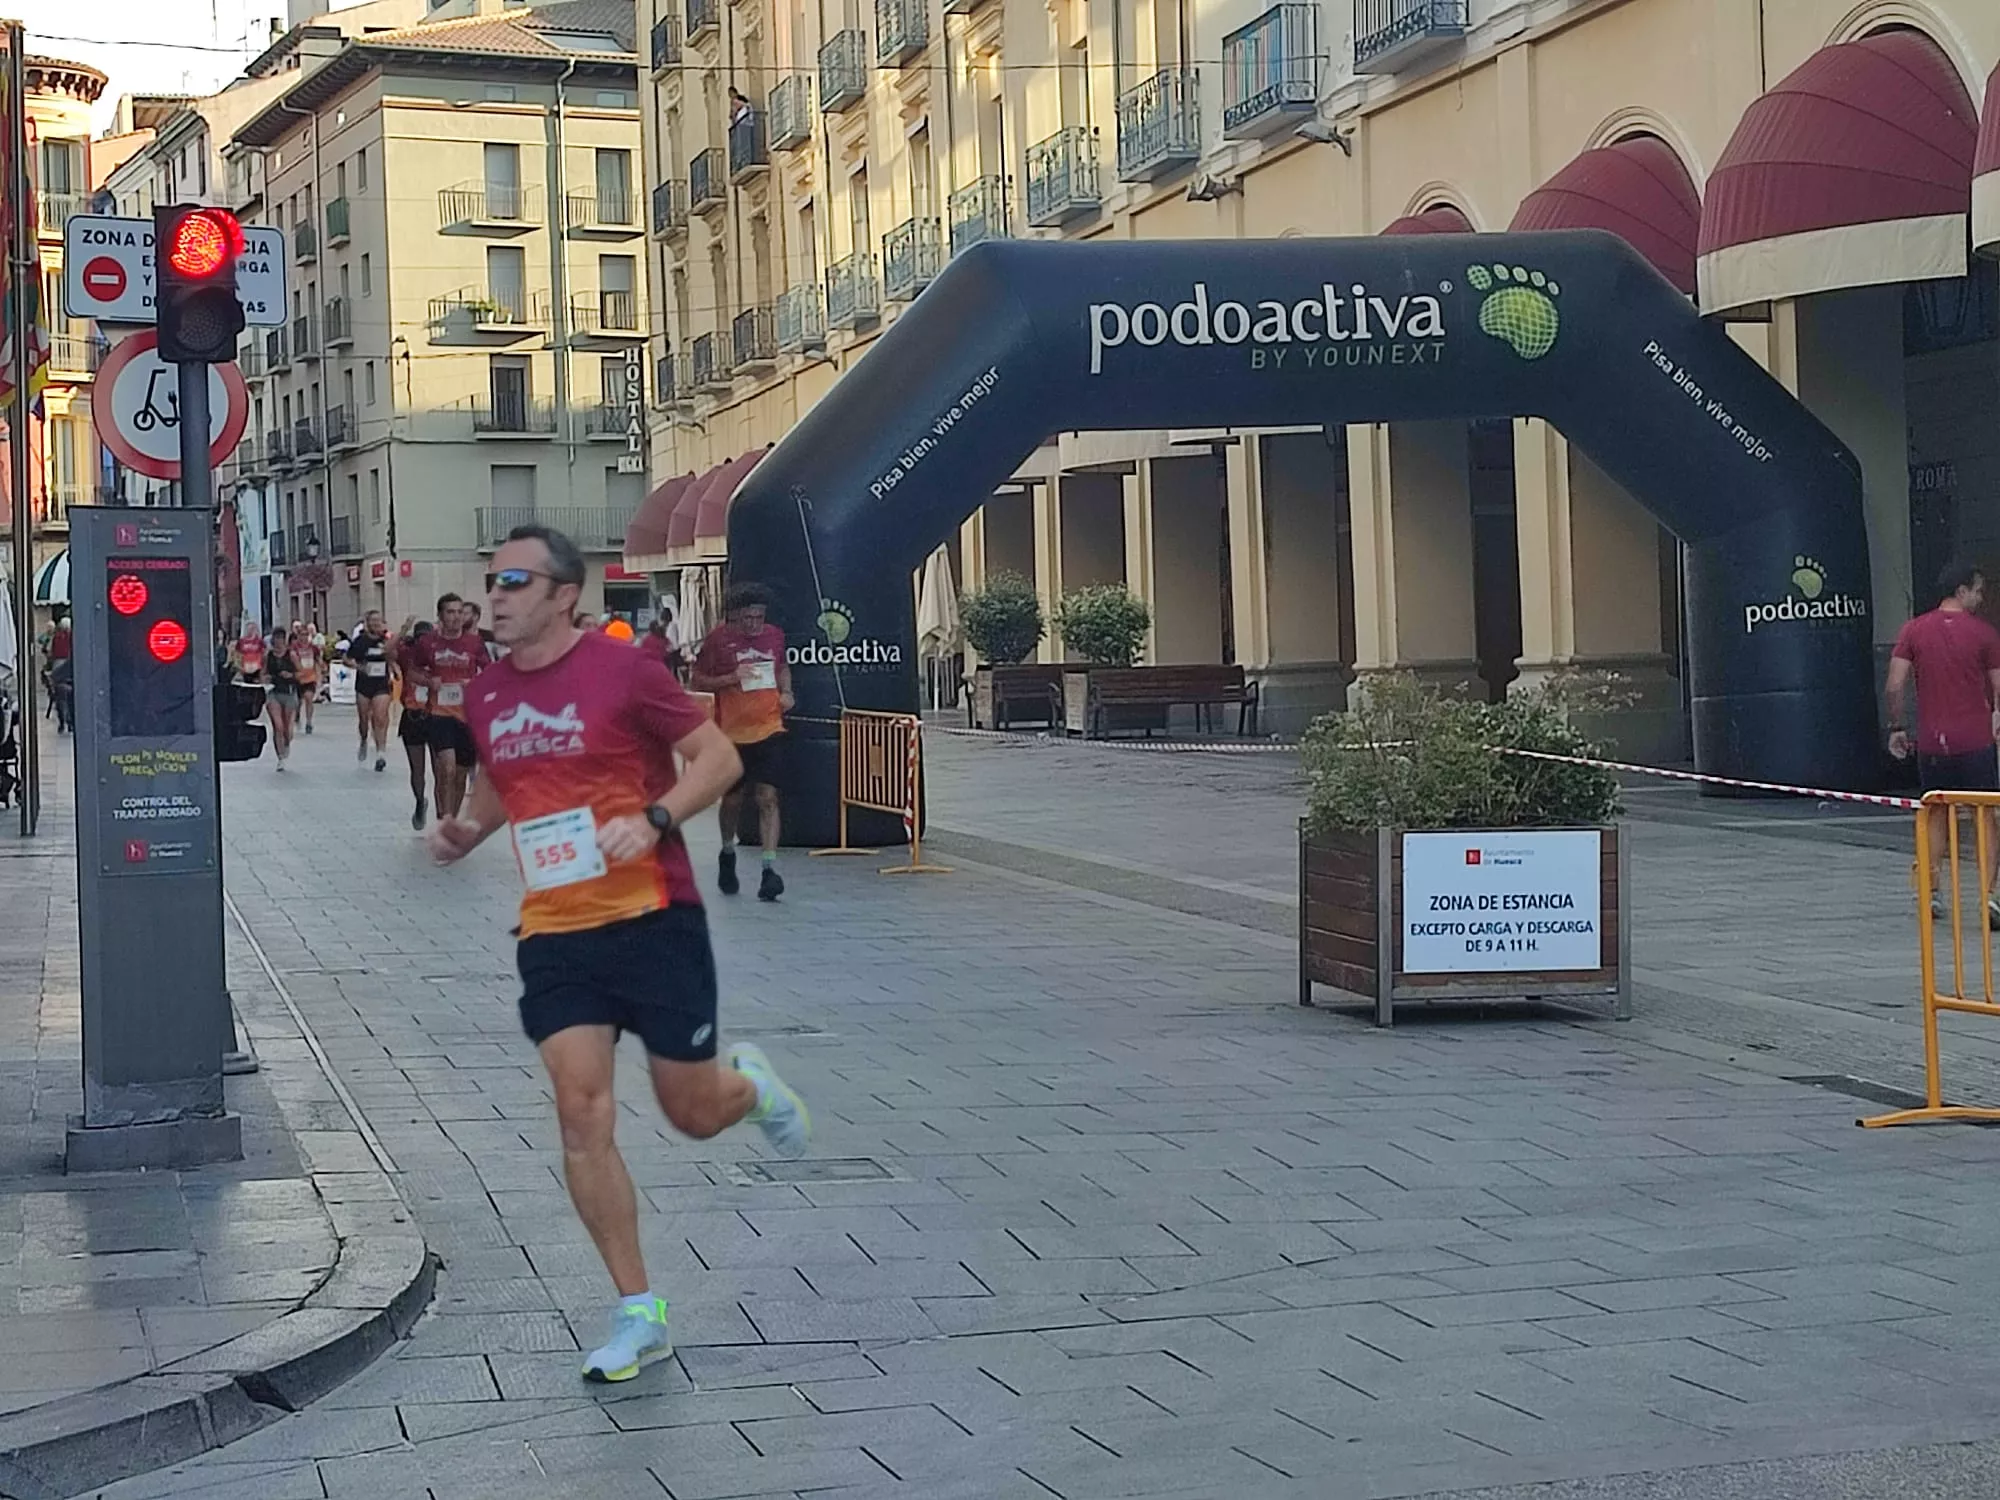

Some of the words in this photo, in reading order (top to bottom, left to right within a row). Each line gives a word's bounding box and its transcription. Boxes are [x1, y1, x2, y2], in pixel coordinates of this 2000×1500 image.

[82, 229, 136, 247] ZONA
[142, 274, 152, 287] Y
[1089, 283, 1446, 374] podoactiva
[1251, 348, 1289, 369] BY
[1305, 342, 1446, 367] YOUNEXT
[625, 346, 642, 452] HOSTAL
[1643, 340, 1674, 375] Pisa
[1672, 367, 1703, 407] bien,
[1706, 399, 1733, 429] vive
[1731, 424, 1773, 462] mejor
[869, 466, 905, 500] Pisa
[899, 434, 939, 470] bien,
[932, 406, 963, 437] vive
[959, 365, 1000, 410] mejor
[1745, 593, 1867, 633] podoactiva
[785, 638, 902, 664] odoactiva
[491, 734, 585, 765] HUESCA
[113, 808, 157, 820] TRAFICO
[158, 807, 201, 818] RODADO
[122, 797, 170, 808] CONTROL
[171, 796, 192, 806] DEL
[533, 840, 577, 869] 555
[1429, 895, 1474, 911] ZONA
[1478, 895, 1499, 910] DE
[1503, 893, 1574, 910] ESTANCIA
[1410, 922, 1466, 936] EXCEPTO
[1468, 921, 1512, 935] CARGA
[1515, 921, 1525, 934] Y
[1527, 920, 1594, 934] DESCARGA
[1465, 940, 1482, 952] DE
[1485, 940, 1493, 952] 9
[1496, 940, 1506, 951] A
[1510, 939, 1523, 951] 11
